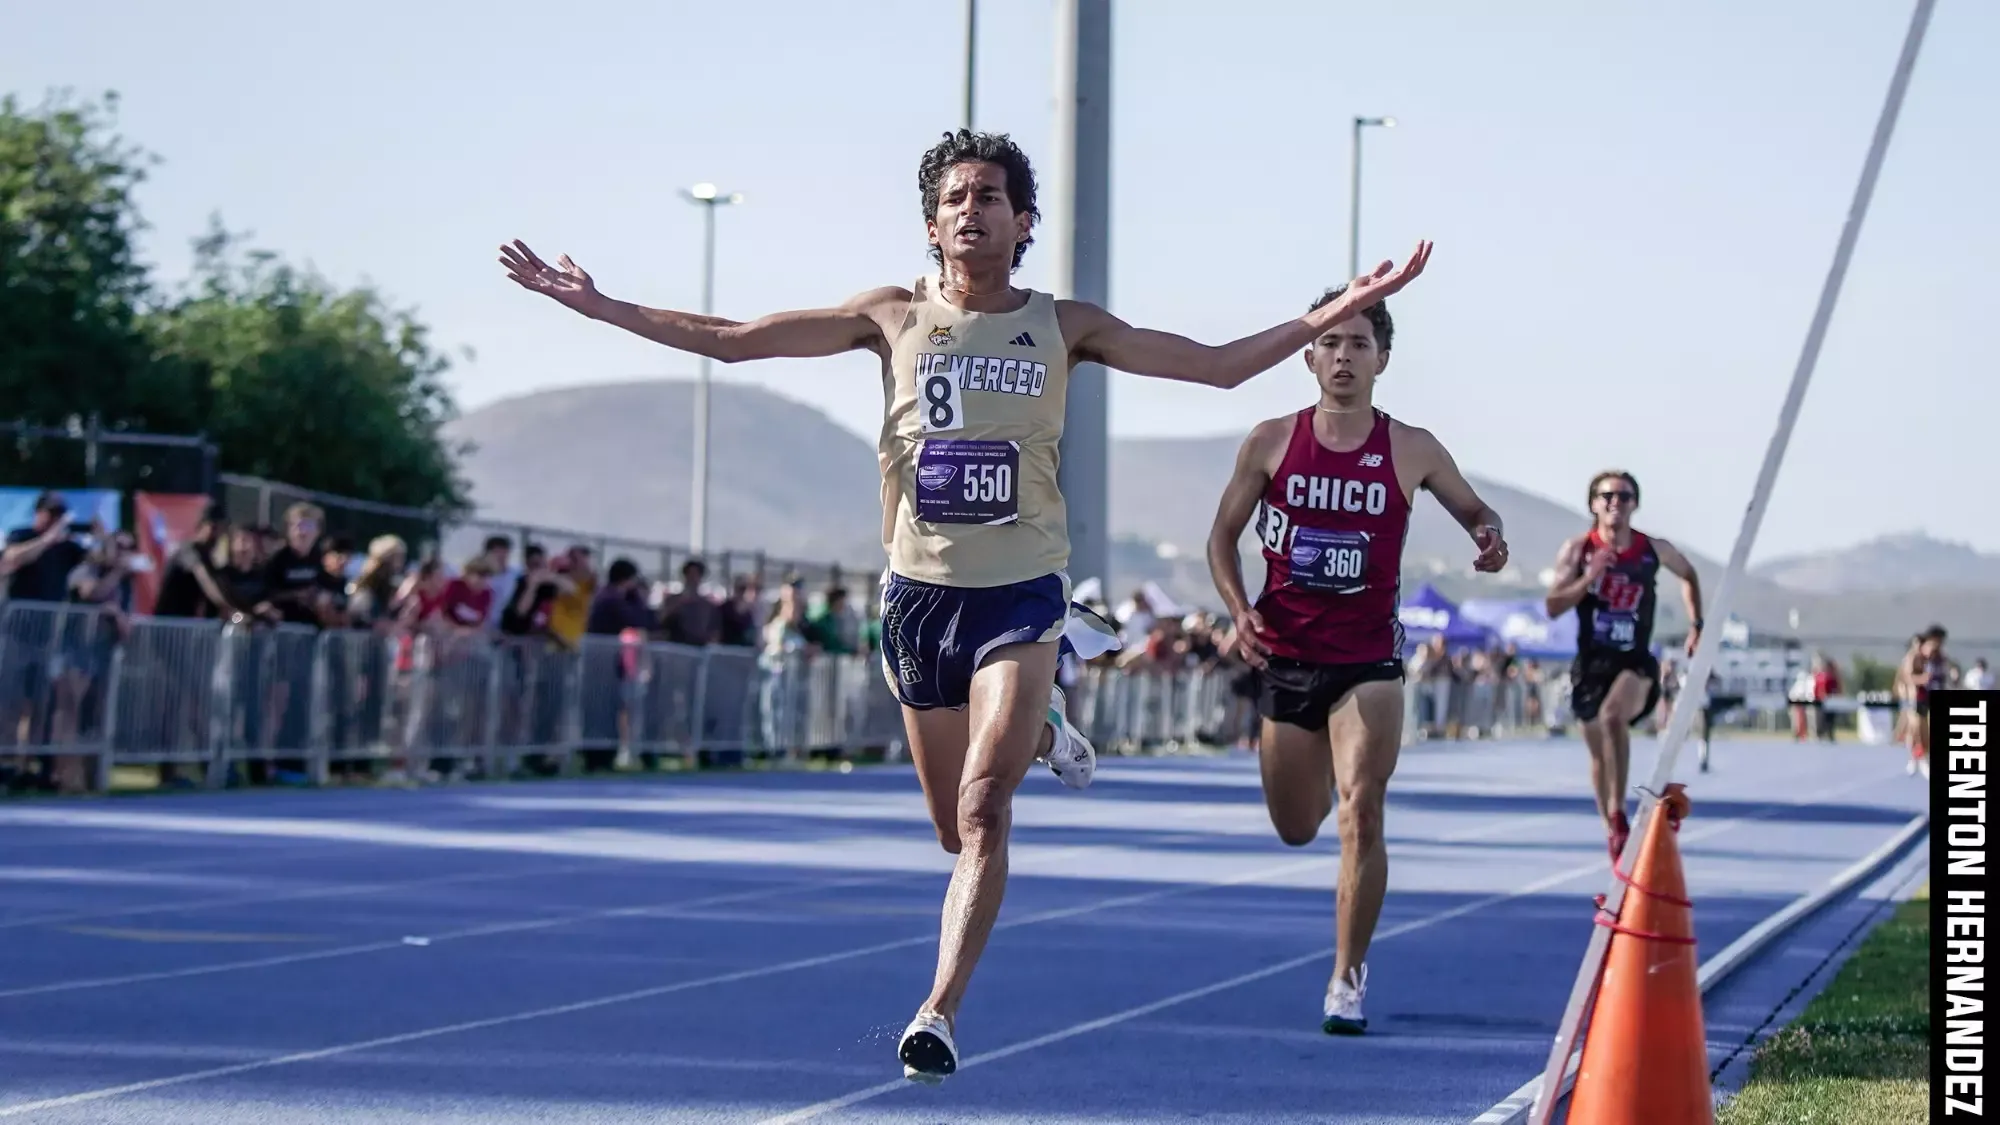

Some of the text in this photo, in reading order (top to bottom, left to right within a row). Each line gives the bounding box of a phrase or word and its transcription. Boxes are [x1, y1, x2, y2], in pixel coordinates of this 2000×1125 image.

[950, 354, 1047, 398] MERCED
[925, 375, 954, 429] 8
[963, 464, 1012, 503] 550
[1286, 474, 1387, 516] CHICO
[1269, 510, 1283, 547] 3
[1323, 547, 1363, 579] 360
